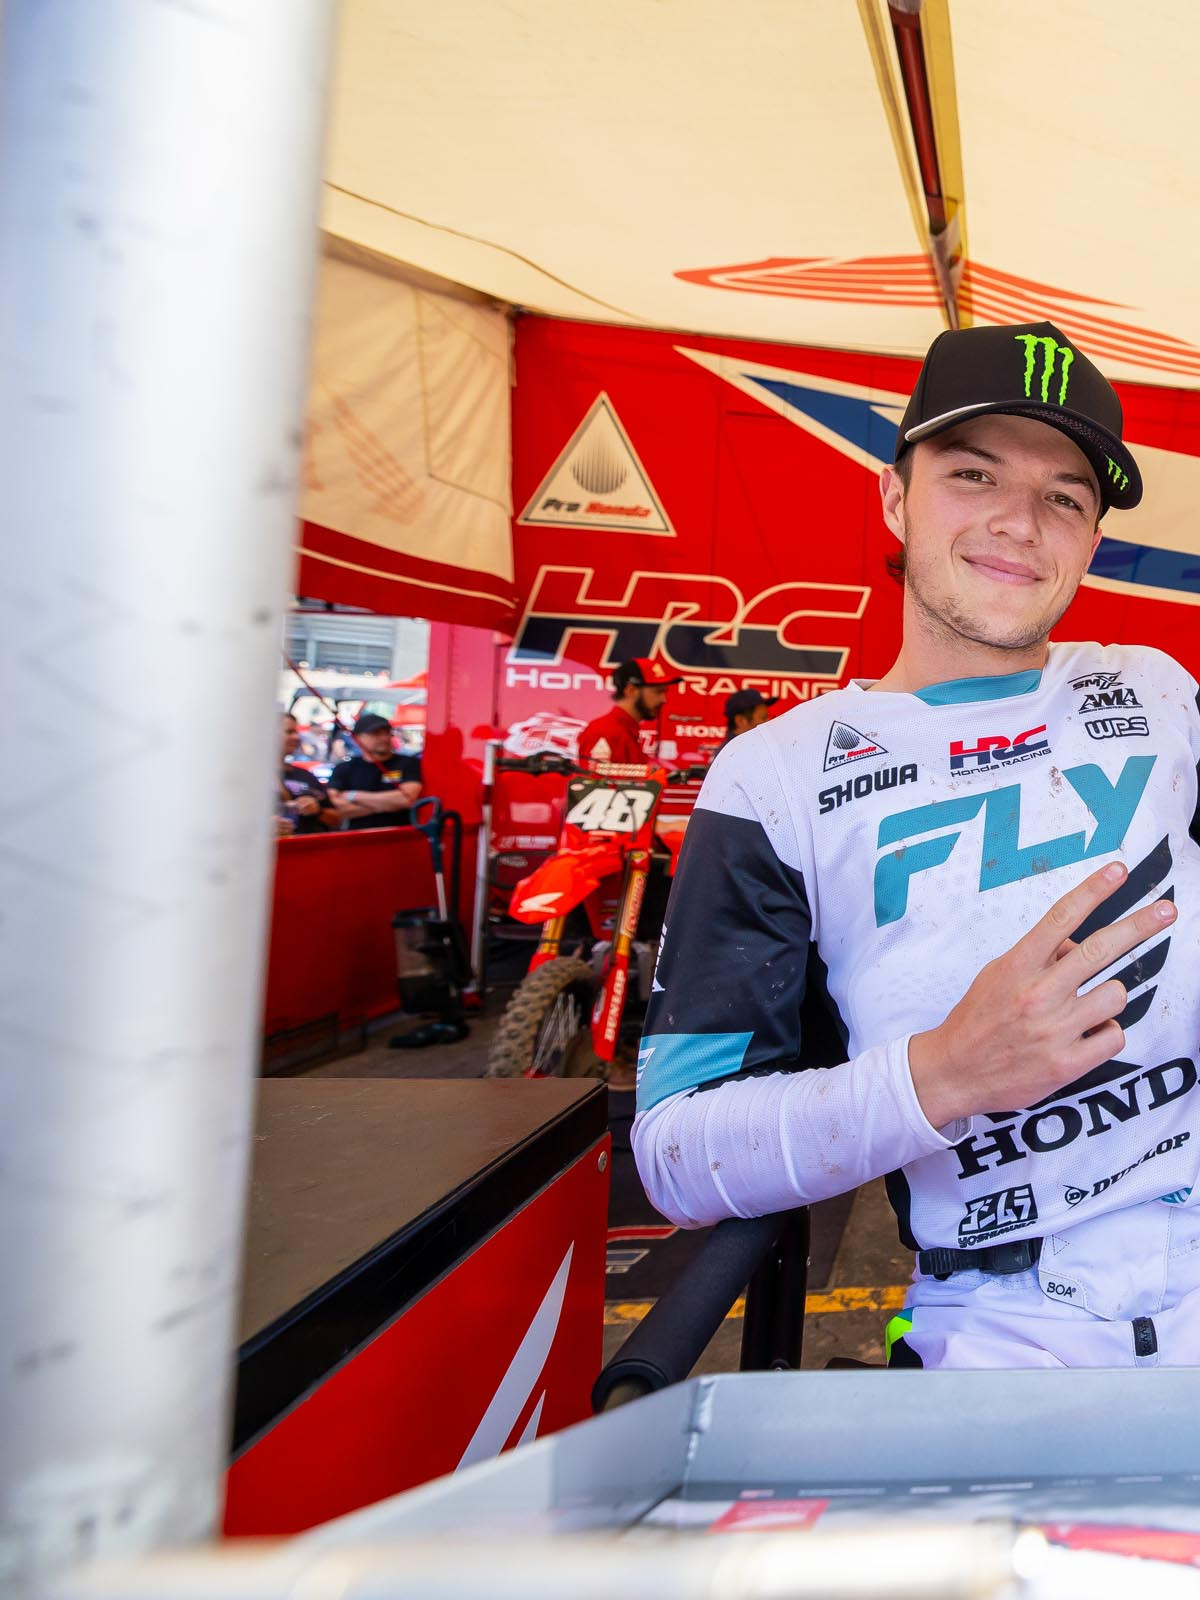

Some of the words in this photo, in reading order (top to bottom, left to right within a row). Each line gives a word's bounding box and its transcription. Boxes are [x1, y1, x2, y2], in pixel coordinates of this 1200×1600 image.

[505, 565, 872, 681] HRC
[1078, 688, 1143, 711] AMA
[675, 724, 728, 738] HON
[950, 724, 1048, 770] HRC
[1085, 716, 1149, 740] WPS
[828, 754, 845, 764] Pro
[951, 763, 1000, 777] Honda
[1002, 747, 1053, 767] RACING
[565, 788, 656, 832] 48
[818, 763, 919, 815] SHOWA
[874, 755, 1158, 928] FLY
[604, 969, 626, 1041] DUNLOP
[1091, 1132, 1190, 1197] DUNLOP
